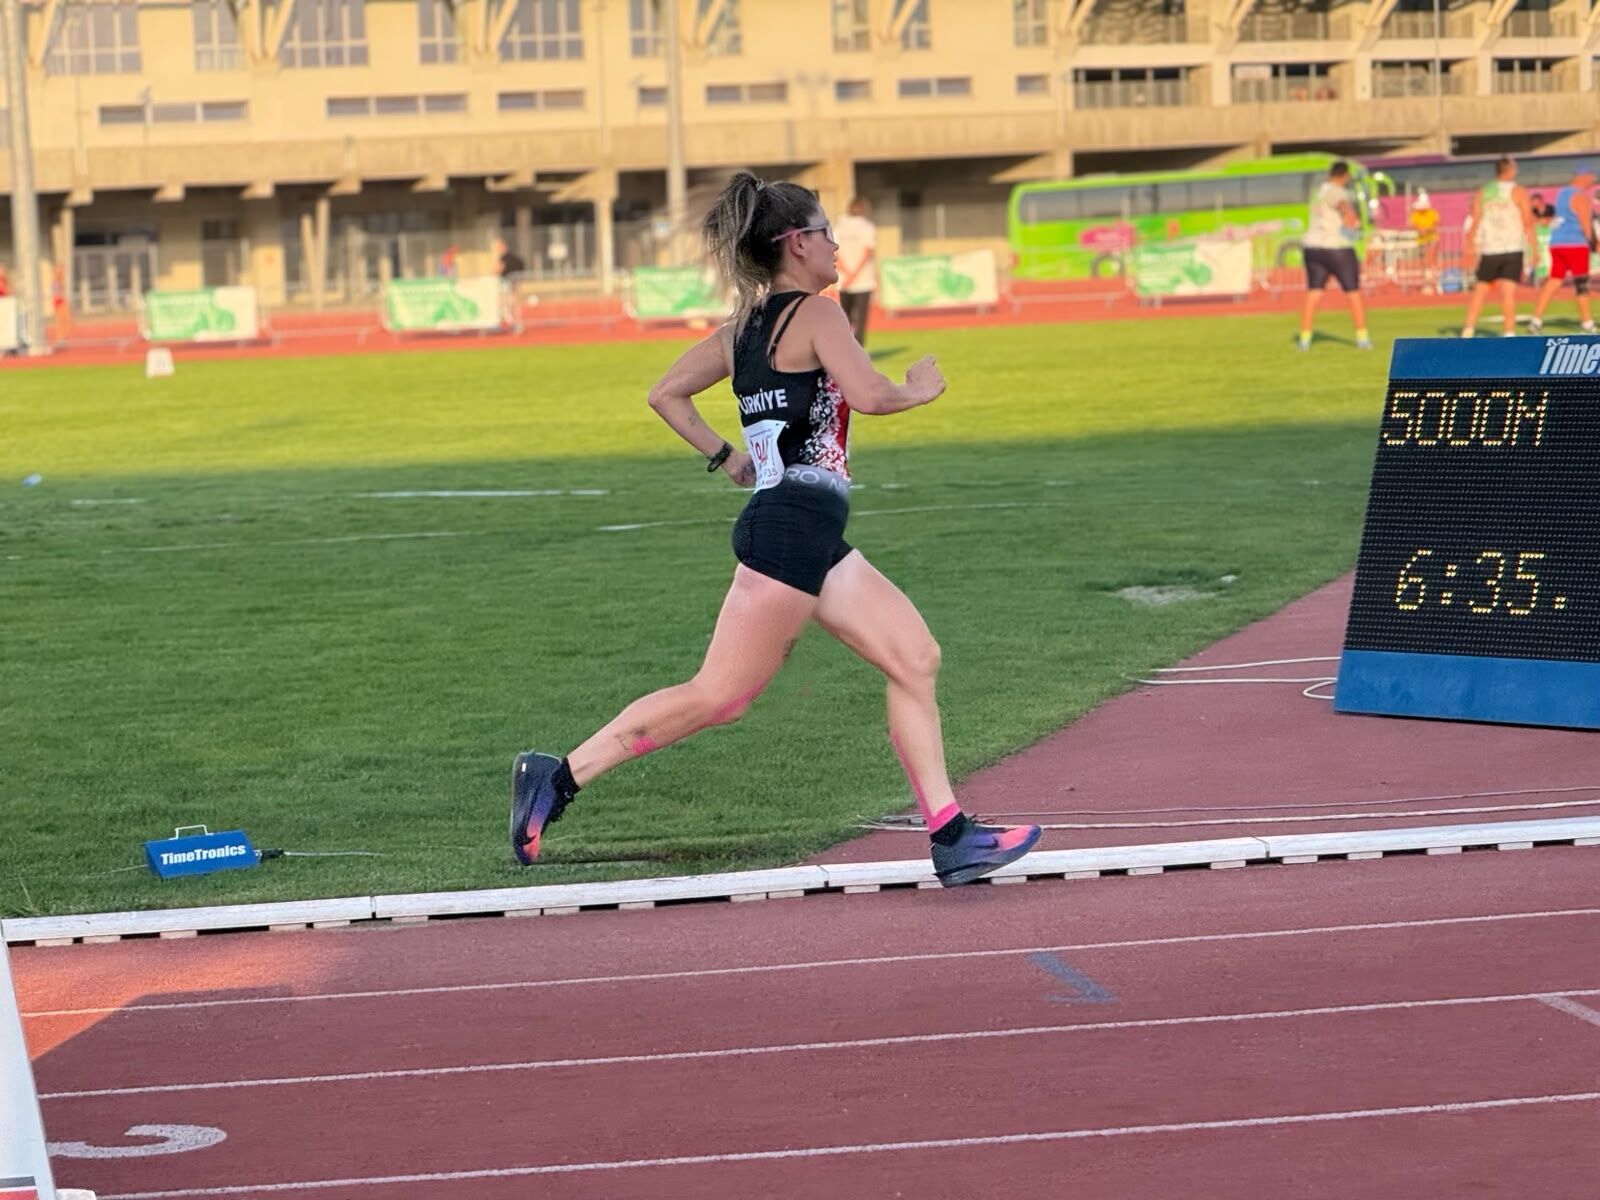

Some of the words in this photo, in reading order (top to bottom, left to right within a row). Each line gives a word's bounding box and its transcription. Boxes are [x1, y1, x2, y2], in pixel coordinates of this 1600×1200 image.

[1539, 338, 1600, 375] Time
[739, 387, 788, 415] ÜRKİYE
[1382, 391, 1550, 447] 5000M
[160, 844, 246, 865] TimeTronics
